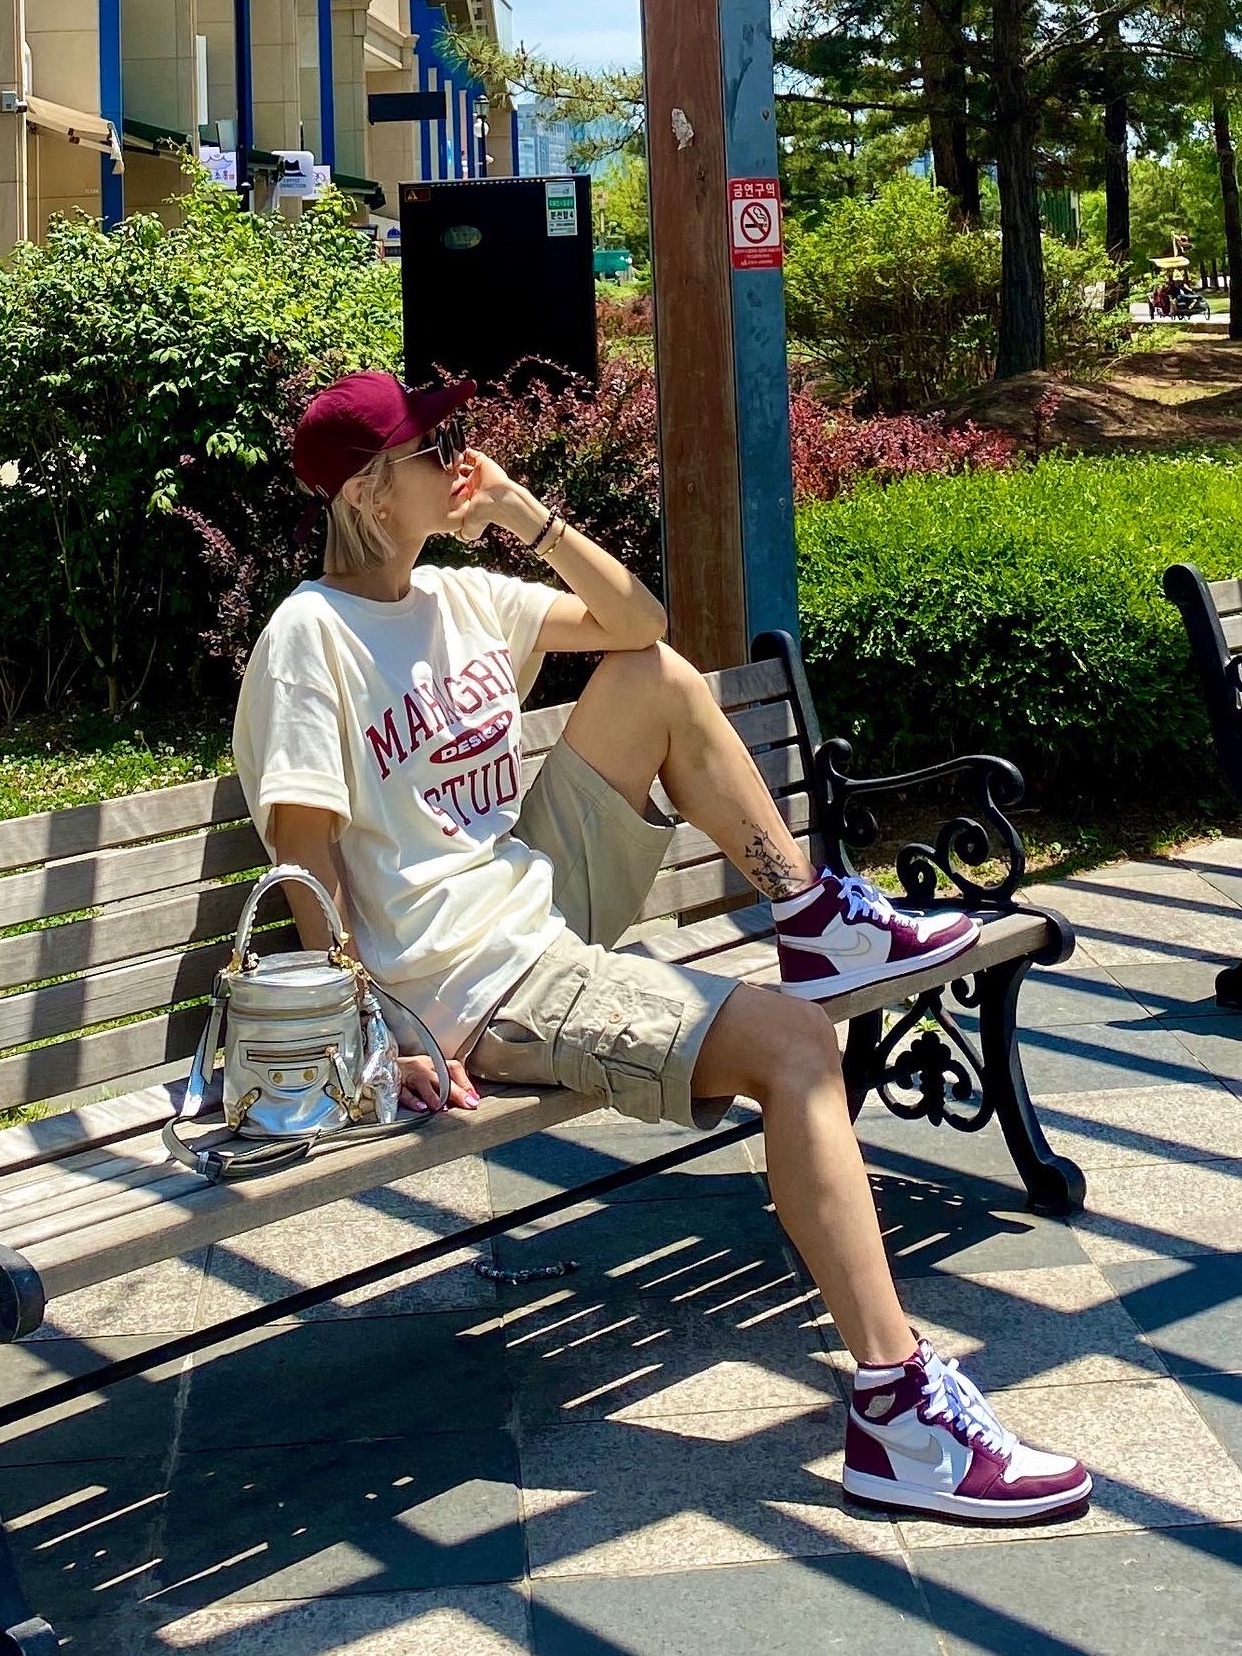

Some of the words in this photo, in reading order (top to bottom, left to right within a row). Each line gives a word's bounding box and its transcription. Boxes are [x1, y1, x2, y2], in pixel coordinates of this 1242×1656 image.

[733, 183, 775, 198] 금연구역
[441, 714, 510, 761] DESIGN
[424, 746, 519, 836] STUD
